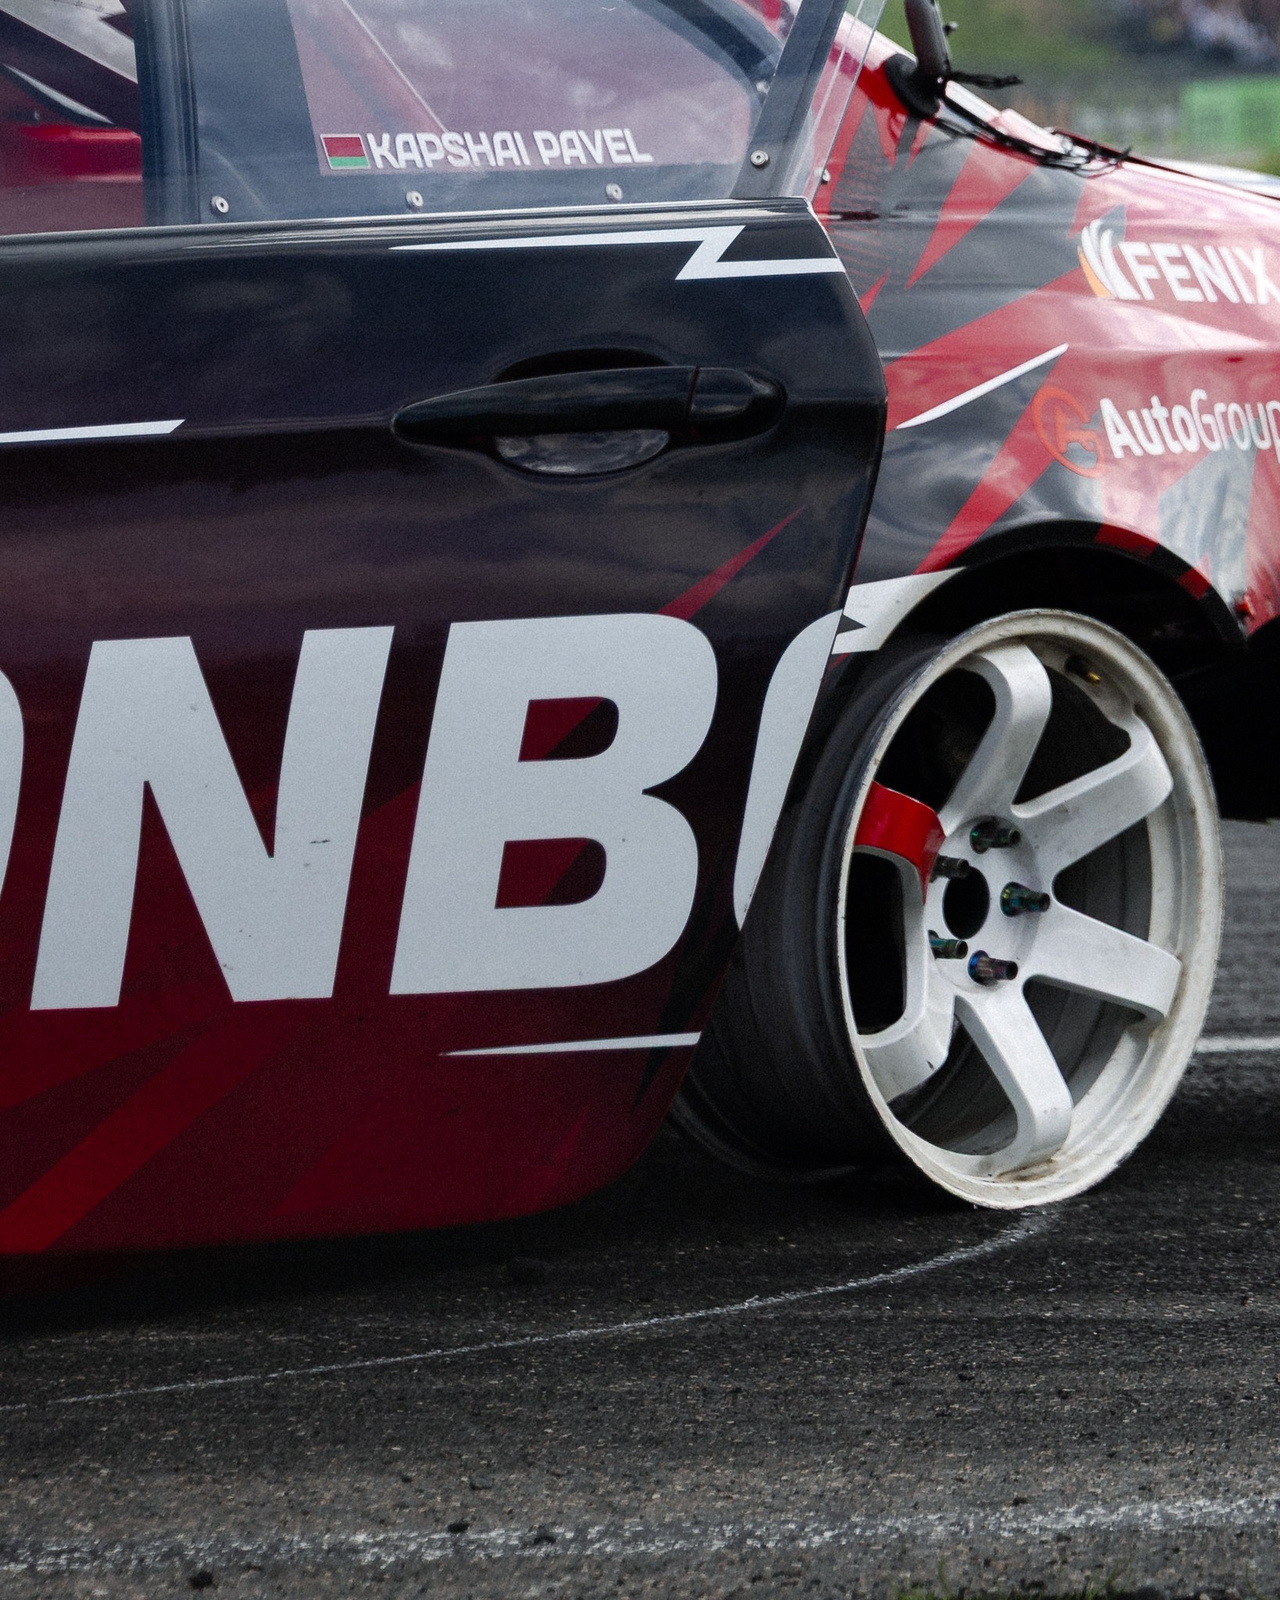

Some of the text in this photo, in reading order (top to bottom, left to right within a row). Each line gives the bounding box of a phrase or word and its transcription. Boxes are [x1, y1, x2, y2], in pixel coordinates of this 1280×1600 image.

[366, 128, 655, 169] KAPSHAI PAVEL
[0, 567, 966, 1011] NB
